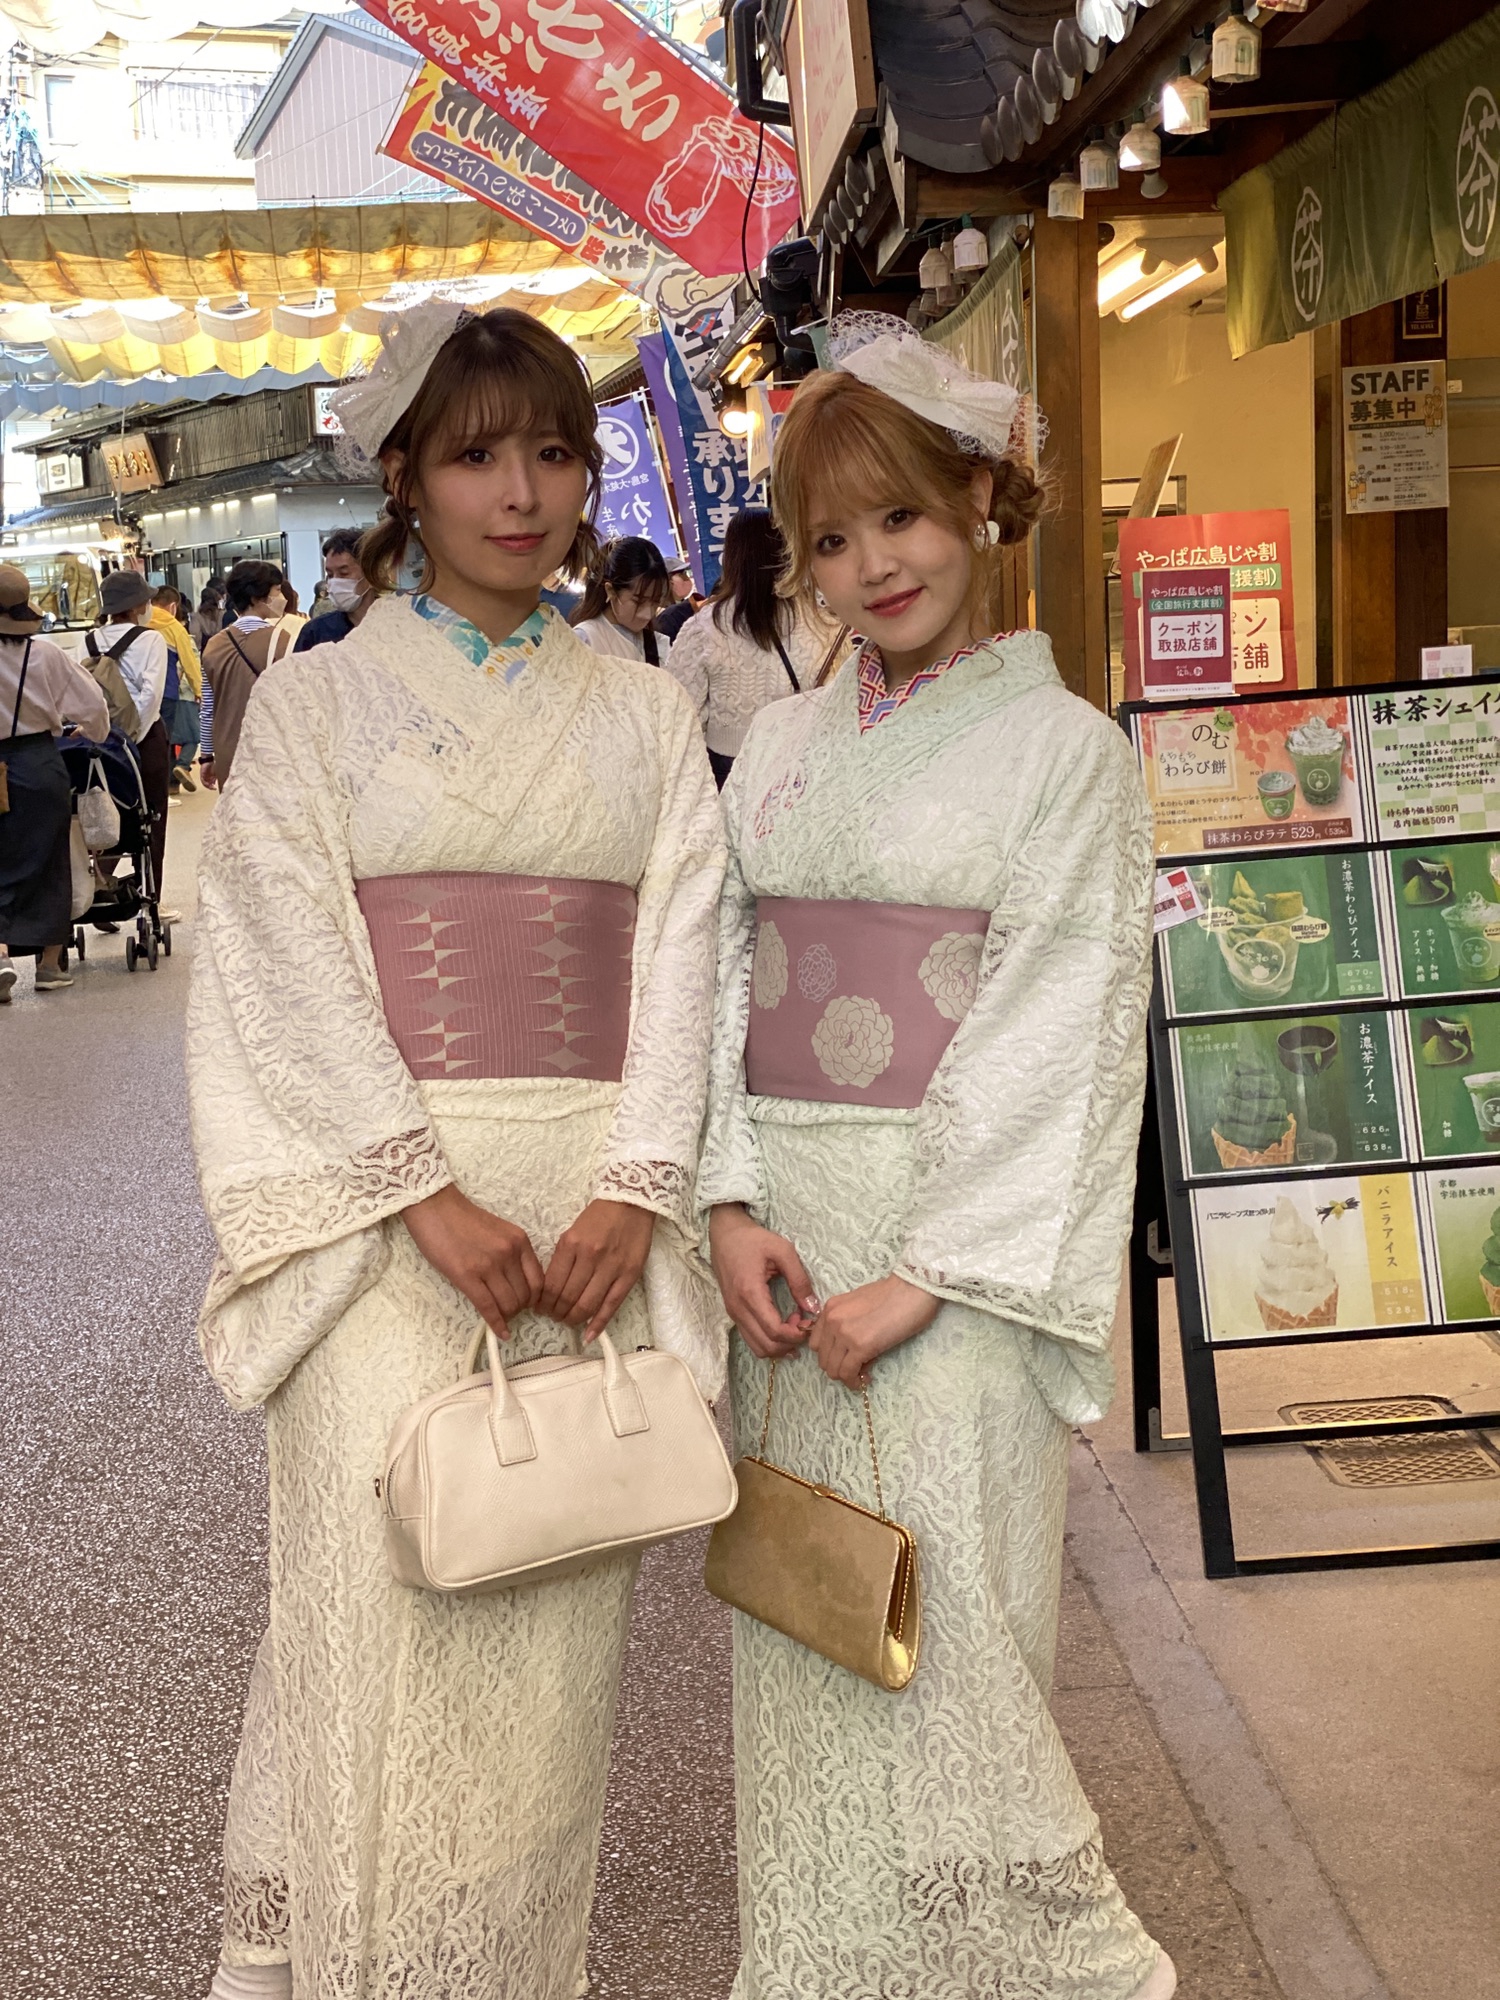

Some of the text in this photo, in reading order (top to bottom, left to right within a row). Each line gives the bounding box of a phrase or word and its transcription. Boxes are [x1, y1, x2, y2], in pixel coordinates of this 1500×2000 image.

[1351, 369, 1430, 396] STAFF
[1350, 397, 1416, 423] 募集中
[1136, 541, 1278, 569] やっぱ広島じゃ割
[1151, 585, 1223, 598] やっぱ広島じゃ割
[1151, 599, 1223, 611] (全国旅行支援割)
[1158, 620, 1217, 637] クーポン
[1158, 637, 1217, 653] 取扱店舗
[1191, 724, 1230, 750] のむ
[1159, 750, 1197, 764] もちもち
[1164, 758, 1227, 777] わらび餅
[1207, 827, 1287, 845] 抹茶わらびラテ
[1341, 859, 1361, 959] お濃茶わらびアイス
[1359, 1023, 1378, 1105] お濃茶アイス
[1377, 1186, 1398, 1268] バニラアイス
